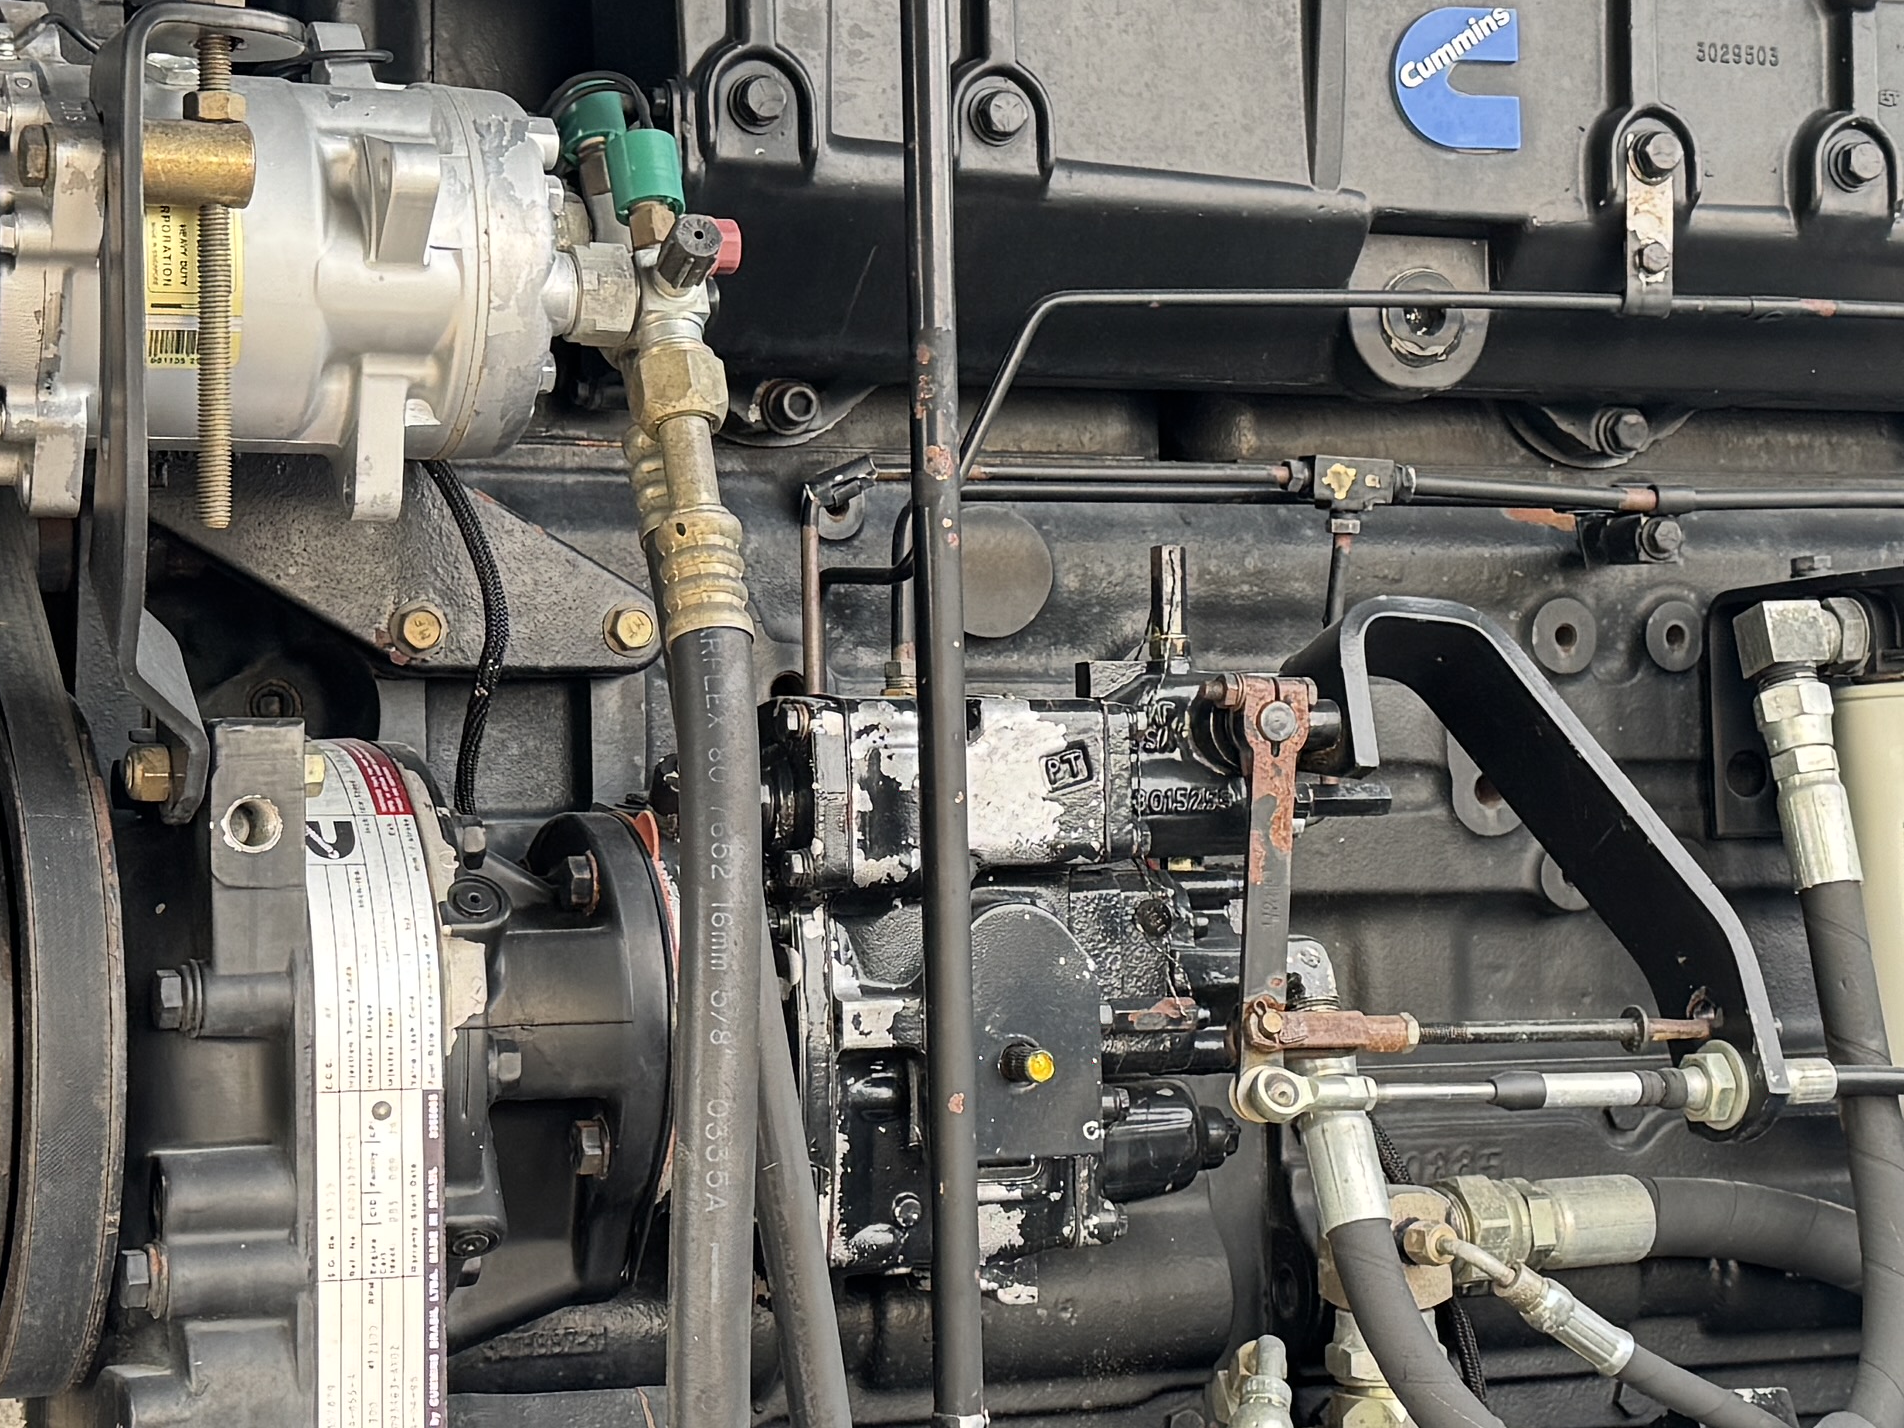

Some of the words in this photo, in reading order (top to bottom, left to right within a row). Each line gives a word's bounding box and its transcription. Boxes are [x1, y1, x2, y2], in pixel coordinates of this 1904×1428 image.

[1400, 8, 1511, 88] Cummins
[1696, 41, 1779, 67] 3029503
[160, 206, 172, 286] RPORATION
[179, 261, 188, 286] DUTY
[1045, 753, 1081, 783] PT
[710, 901, 734, 970] 16mm
